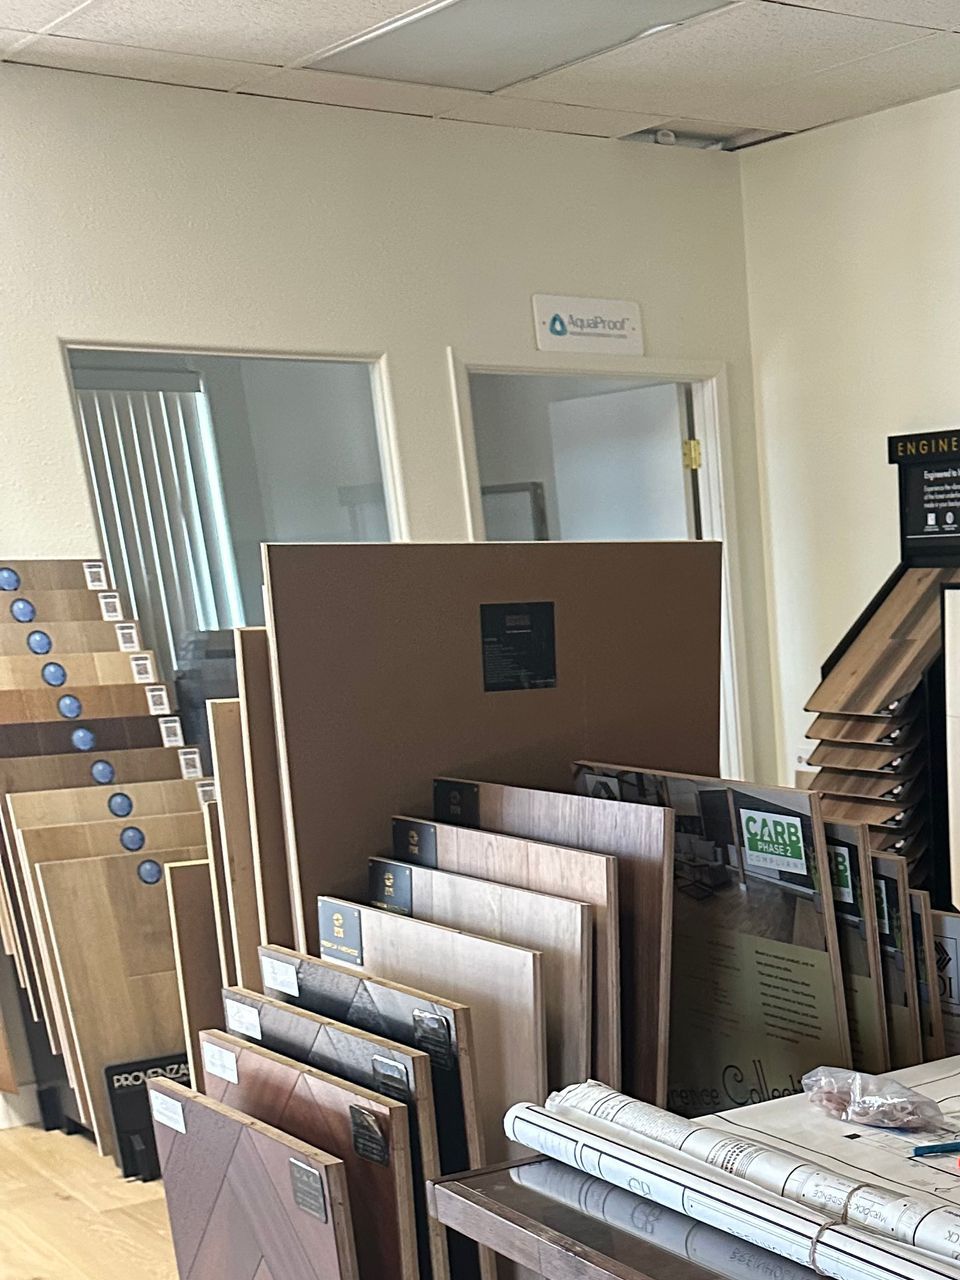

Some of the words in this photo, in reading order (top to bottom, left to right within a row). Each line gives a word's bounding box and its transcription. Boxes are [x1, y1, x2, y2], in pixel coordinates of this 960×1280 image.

[745, 816, 800, 846] CARB
[758, 842, 785, 855] PHASE
[786, 847, 792, 856] 2
